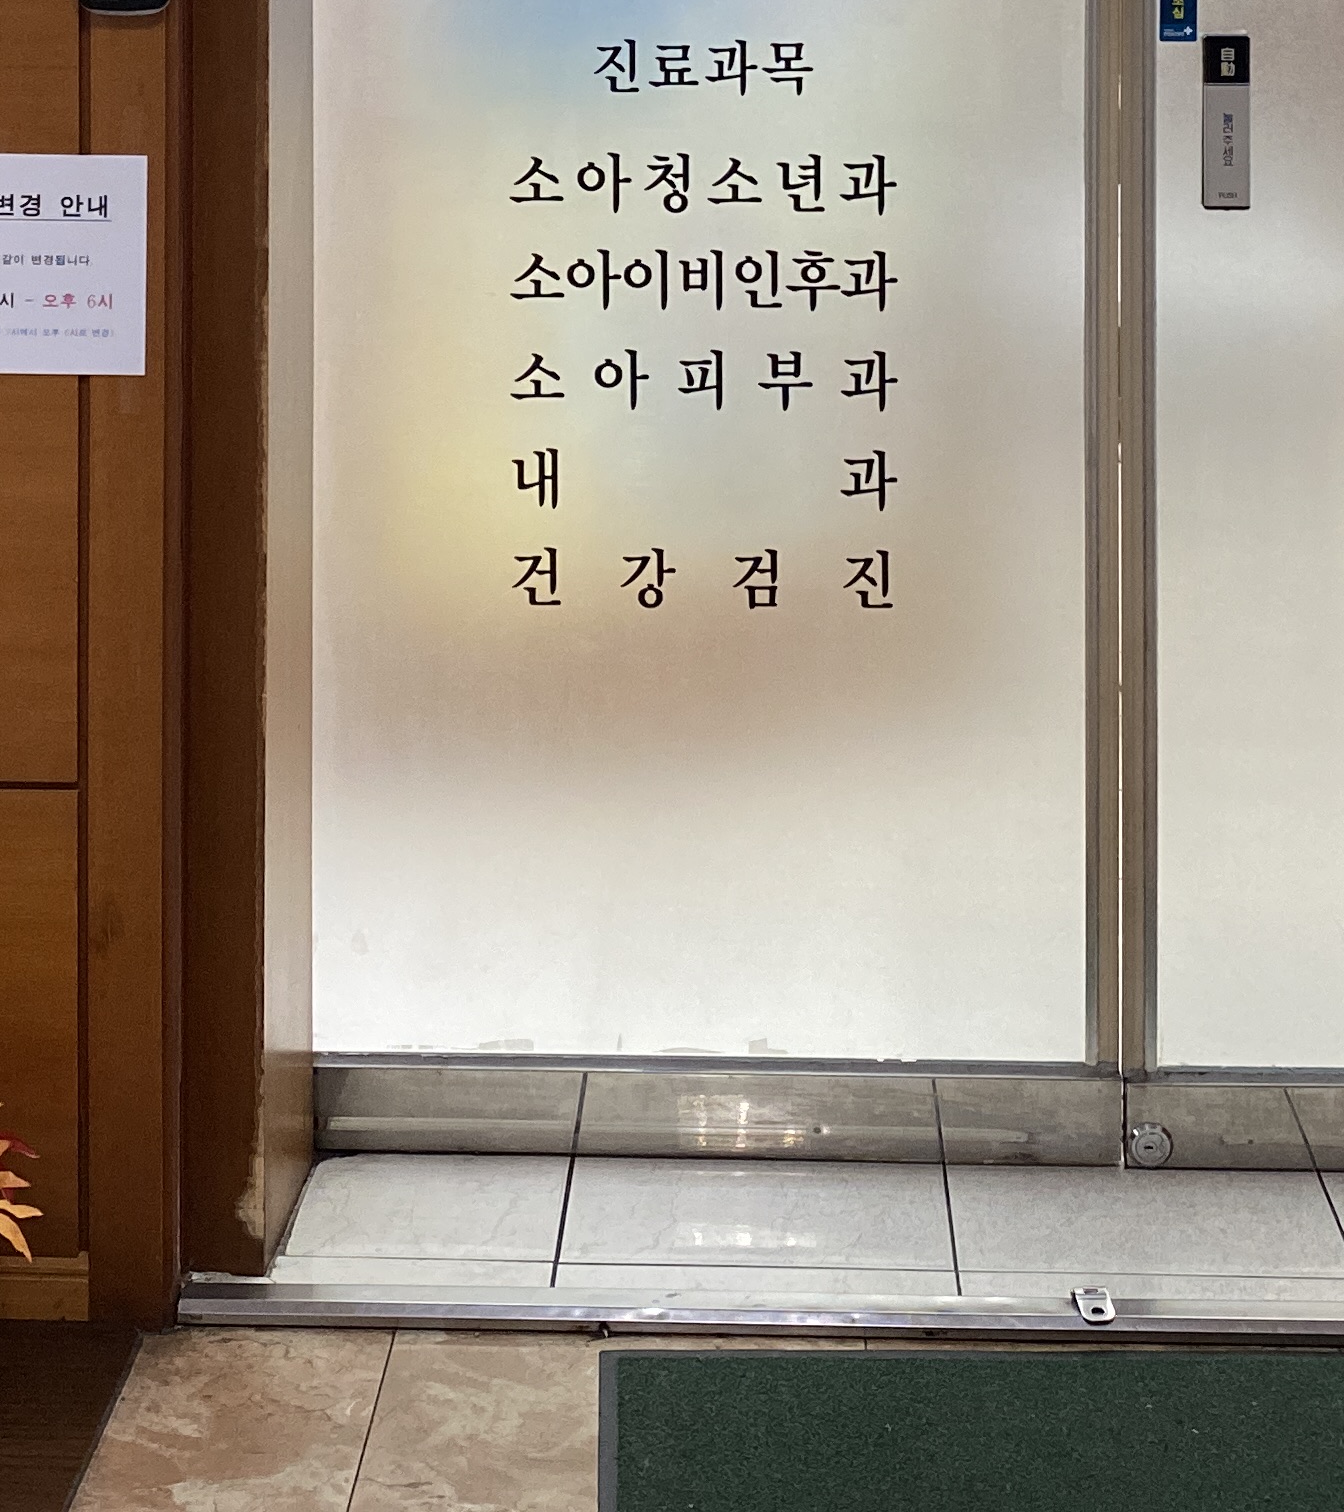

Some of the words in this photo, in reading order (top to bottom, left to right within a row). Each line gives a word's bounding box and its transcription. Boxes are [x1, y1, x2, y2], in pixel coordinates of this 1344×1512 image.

[593, 38, 815, 97] 진료과목
[59, 193, 110, 219] 안내
[508, 151, 898, 217] 소아청소년과
[42, 292, 77, 309] 오후
[86, 292, 114, 310] 6시
[509, 248, 899, 313] 소아이비인후과
